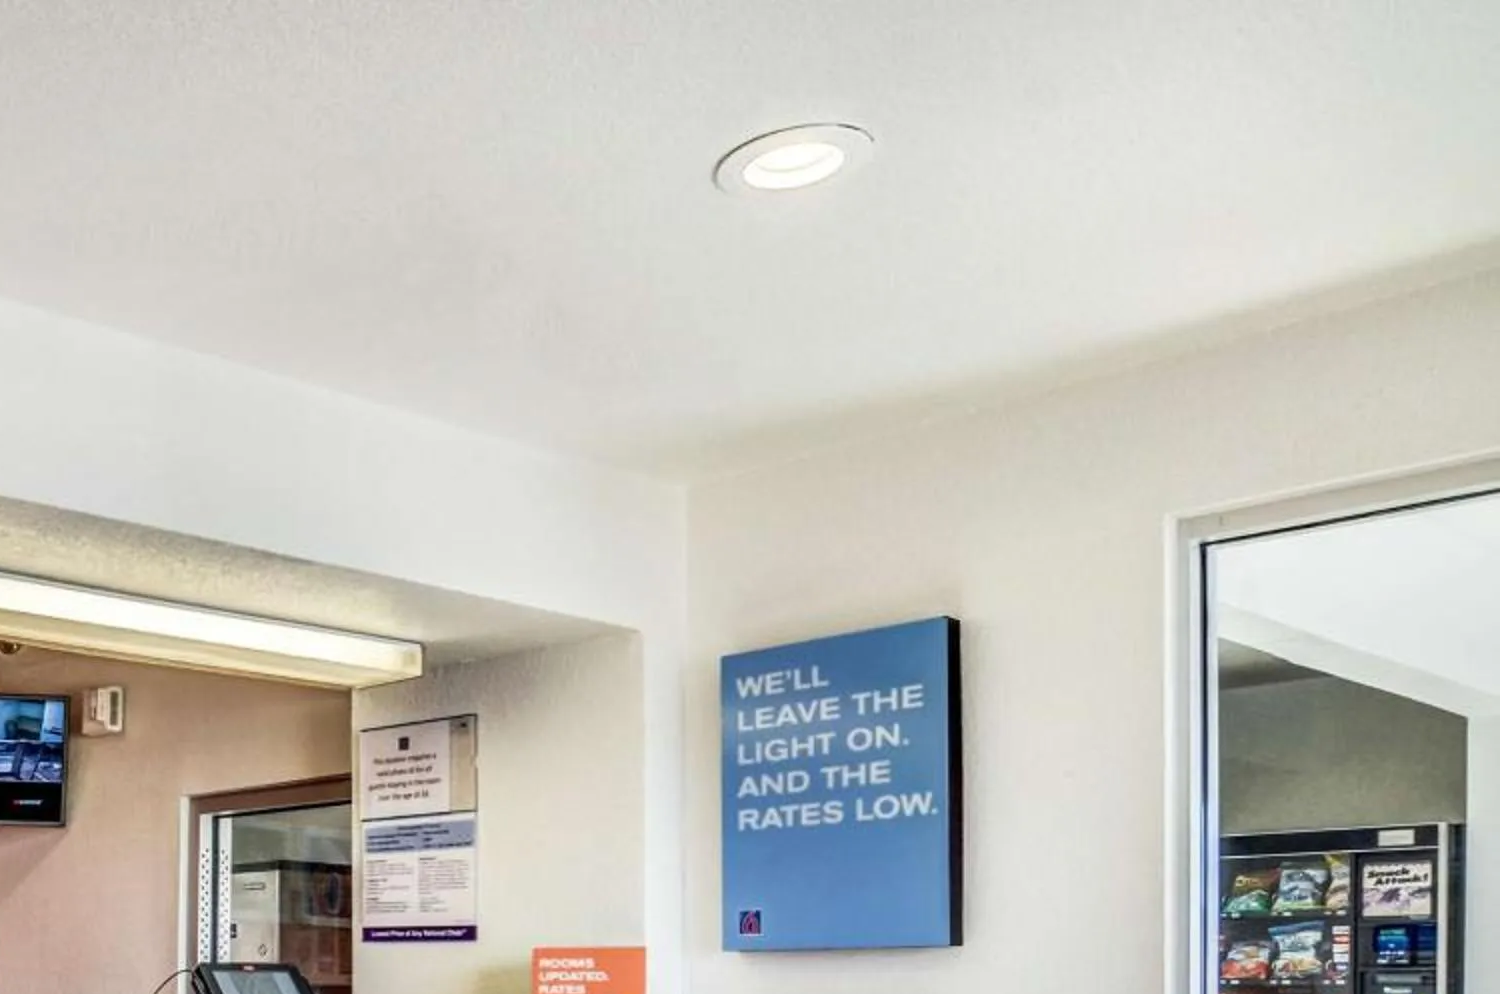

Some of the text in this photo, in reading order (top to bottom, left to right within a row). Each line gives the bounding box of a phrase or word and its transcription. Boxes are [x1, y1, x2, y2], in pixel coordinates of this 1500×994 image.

[736, 665, 829, 698] WE'LL
[737, 684, 924, 732] LEAVE THE
[737, 723, 910, 765] LIGHT ON.
[737, 759, 892, 799] AND THE
[737, 792, 939, 831] RATES LOW.
[539, 957, 595, 969] ROOMS
[539, 970, 610, 982] UPDATED.
[538, 983, 586, 994] RATES
